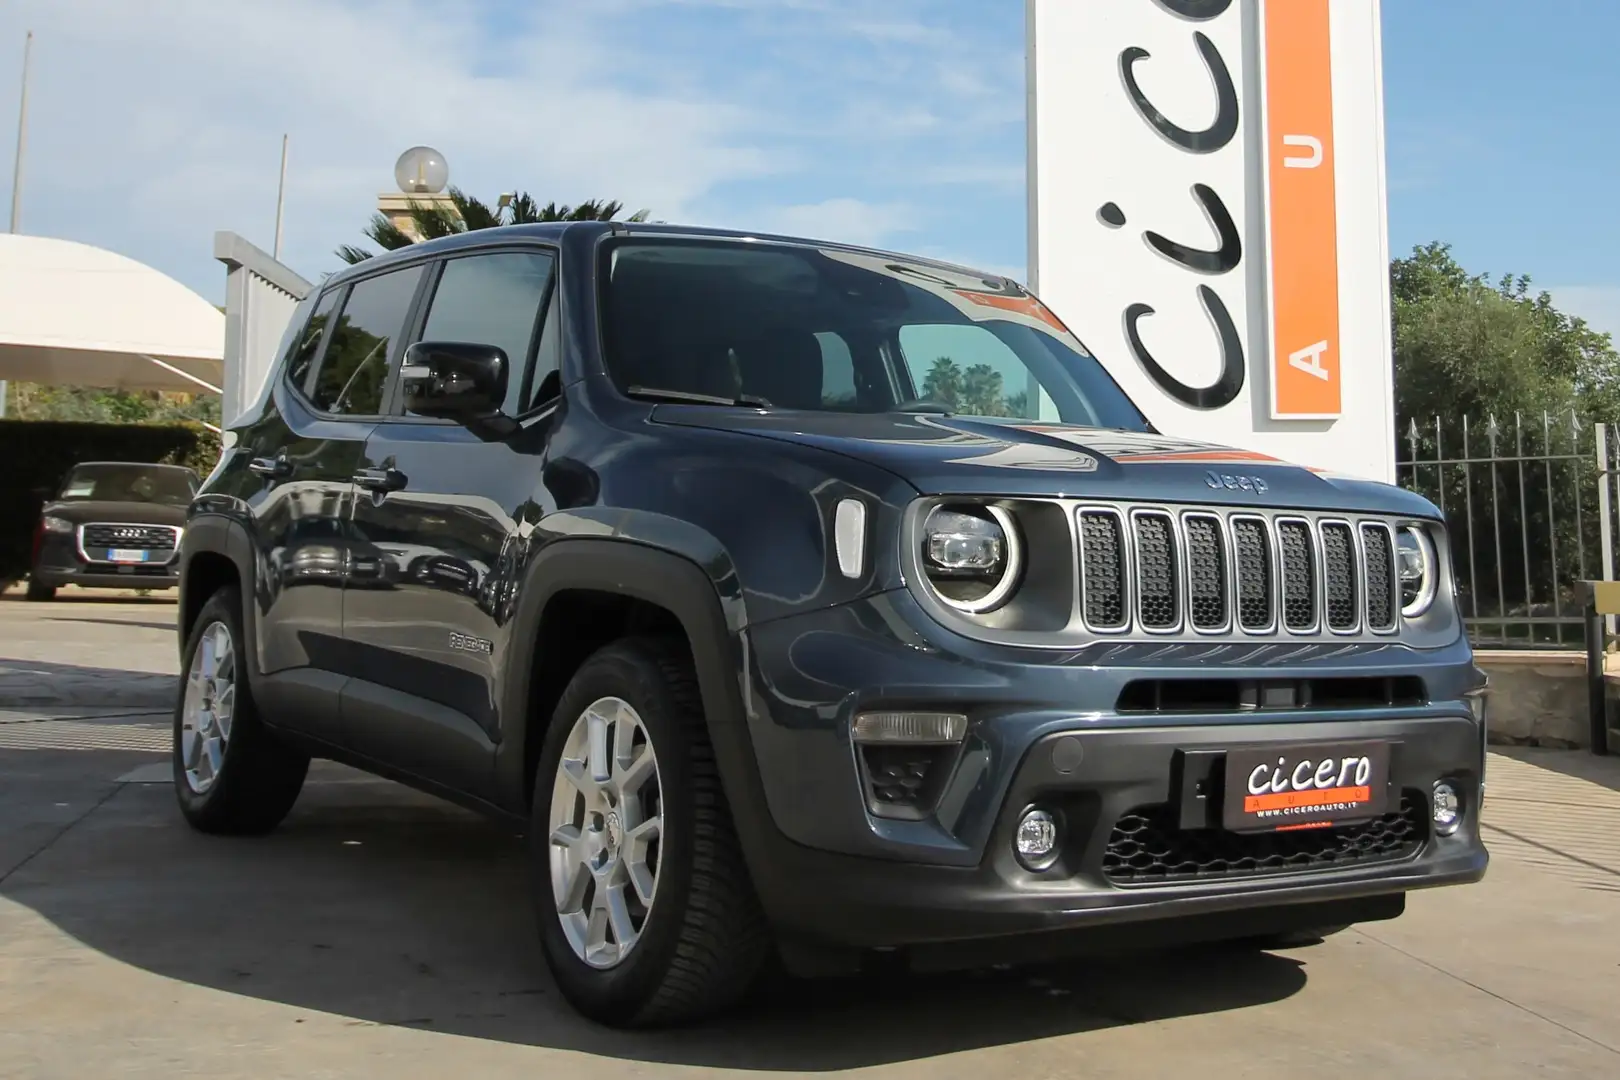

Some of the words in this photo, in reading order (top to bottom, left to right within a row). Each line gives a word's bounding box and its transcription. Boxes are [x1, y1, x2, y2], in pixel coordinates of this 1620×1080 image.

[1096, 0, 1245, 411] cic
[1203, 470, 1269, 496] Jeep
[1247, 756, 1371, 795] cicero
[1256, 801, 1357, 818] WWW.CICEROAUTO.IT
